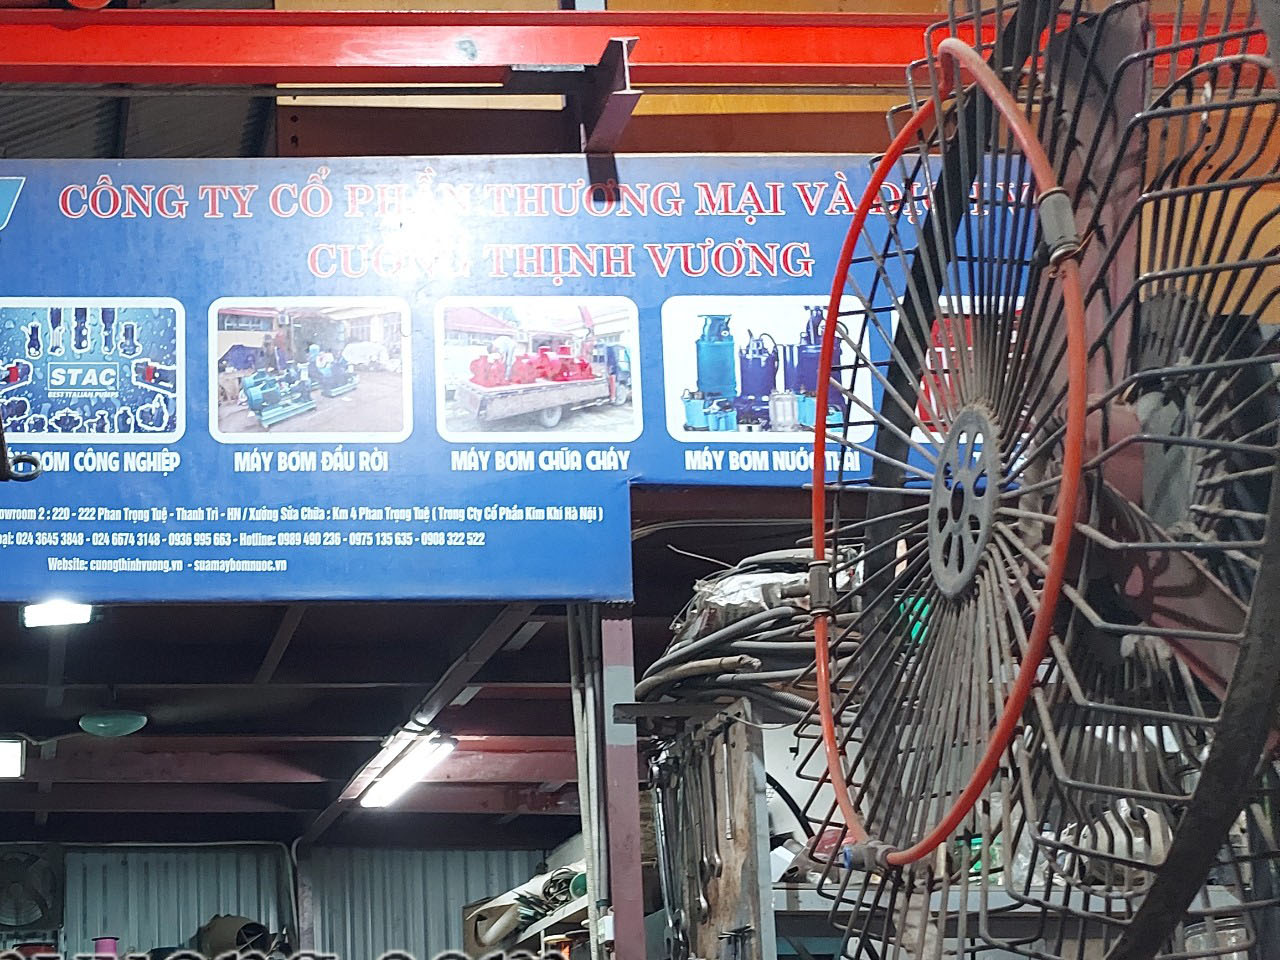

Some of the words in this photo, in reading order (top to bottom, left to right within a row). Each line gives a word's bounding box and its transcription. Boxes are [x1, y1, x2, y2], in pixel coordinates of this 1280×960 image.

[58, 174, 188, 218] CÔNG
[199, 184, 258, 218] TY
[269, 166, 332, 218] CỔ
[482, 178, 684, 217] THƯƠNG
[694, 181, 785, 225] MẠI
[793, 171, 858, 216] VÀ
[483, 243, 635, 287] THỊNH
[644, 238, 815, 278] VƯƠNG
[50, 367, 117, 386] STAC
[74, 447, 119, 472] CÔNG
[124, 447, 180, 477] NGHIỆP
[234, 447, 273, 472] MÁY
[278, 450, 316, 472] BƠM
[451, 446, 490, 471] MÁY
[495, 450, 534, 471] BƠM
[586, 446, 630, 471] CHÁY
[685, 446, 724, 471] MÁY
[729, 450, 769, 471] BƠM
[38, 506, 45, 521] 2
[52, 506, 70, 521] 220
[78, 507, 96, 521] 222
[98, 507, 121, 521] Phan
[123, 507, 149, 524] Trọng
[151, 506, 168, 524] Tuệ
[176, 506, 204, 521] Thanh
[227, 507, 240, 521] HN
[332, 506, 348, 521] Km
[350, 506, 357, 521] 4
[359, 506, 383, 521] Phan
[385, 507, 411, 524] Trọng
[413, 506, 430, 523] Tuệ
[467, 506, 482, 522] Cty
[525, 506, 544, 521] Kim
[580, 506, 596, 524] Nội
[16, 531, 33, 546] 024
[36, 531, 58, 546] 3645
[61, 531, 83, 546] 3848
[92, 532, 110, 546] 024
[137, 532, 160, 546] 3148
[169, 532, 192, 546] 0936
[194, 532, 211, 546] 995
[240, 532, 276, 546] Hotline:
[278, 532, 301, 546] 0989
[303, 531, 321, 546] 490
[323, 531, 341, 546] 236
[349, 531, 373, 546] 0975
[375, 531, 393, 546] 135
[395, 531, 413, 546] 635
[421, 531, 445, 546] 0908
[447, 531, 465, 546] 322
[467, 531, 485, 546] 522
[48, 557, 88, 571] Website:
[90, 557, 183, 573] cuongthinhvuong.vn
[194, 557, 287, 573] suamaybomnuoc.vn
